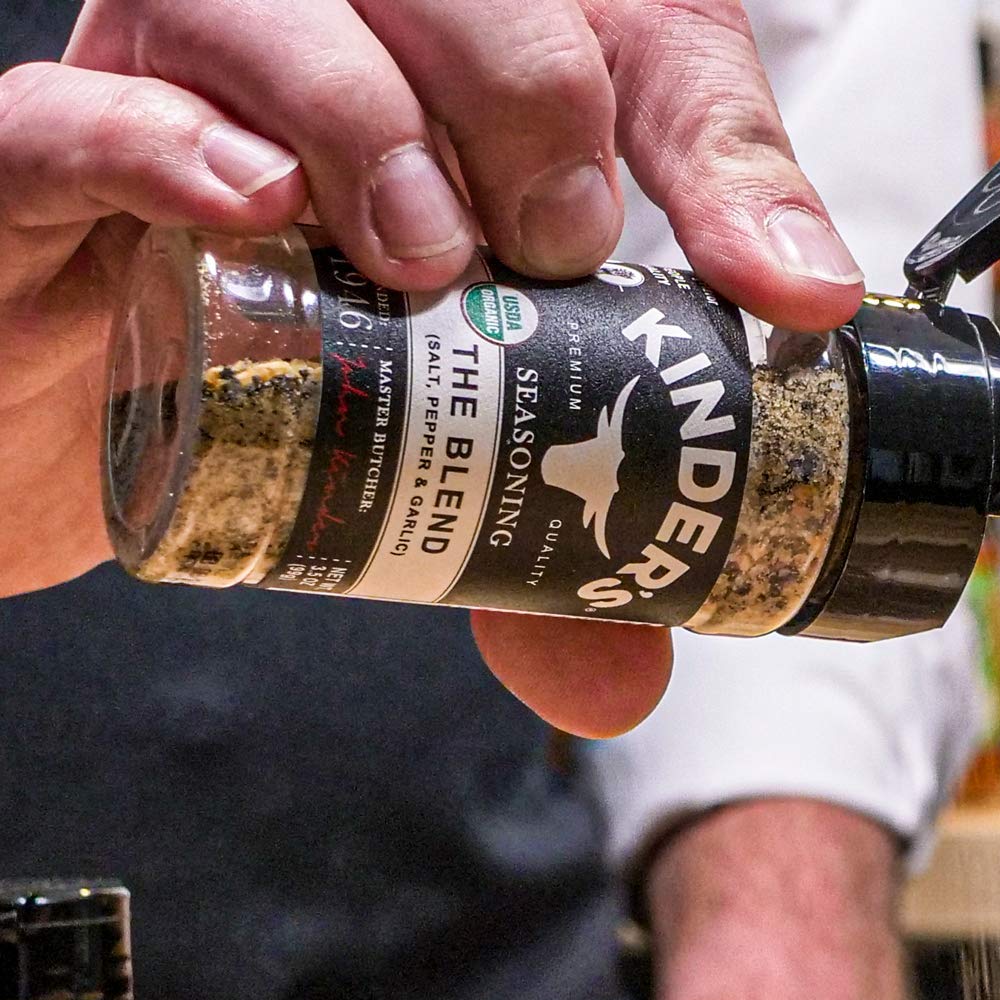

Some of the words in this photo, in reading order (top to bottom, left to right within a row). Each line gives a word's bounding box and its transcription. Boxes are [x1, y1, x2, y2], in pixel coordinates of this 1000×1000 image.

[480, 288, 500, 334] ORGANIC
[502, 295, 523, 331] USDA
[376, 359, 393, 427] MASTER
[424, 333, 443, 389] (SALT,
[449, 344, 479, 418] THE
[566, 321, 582, 411] PREMIUM
[418, 396, 440, 473] PEPPER
[489, 366, 539, 549] SEASONING
[577, 307, 737, 610] KINDER'S
[358, 433, 387, 513] BUTCHER:
[413, 478, 428, 488] &
[421, 436, 474, 555] BLEND
[389, 494, 425, 557] GARLIC)
[526, 518, 562, 586] QUALITY
[324, 566, 348, 583] NET
